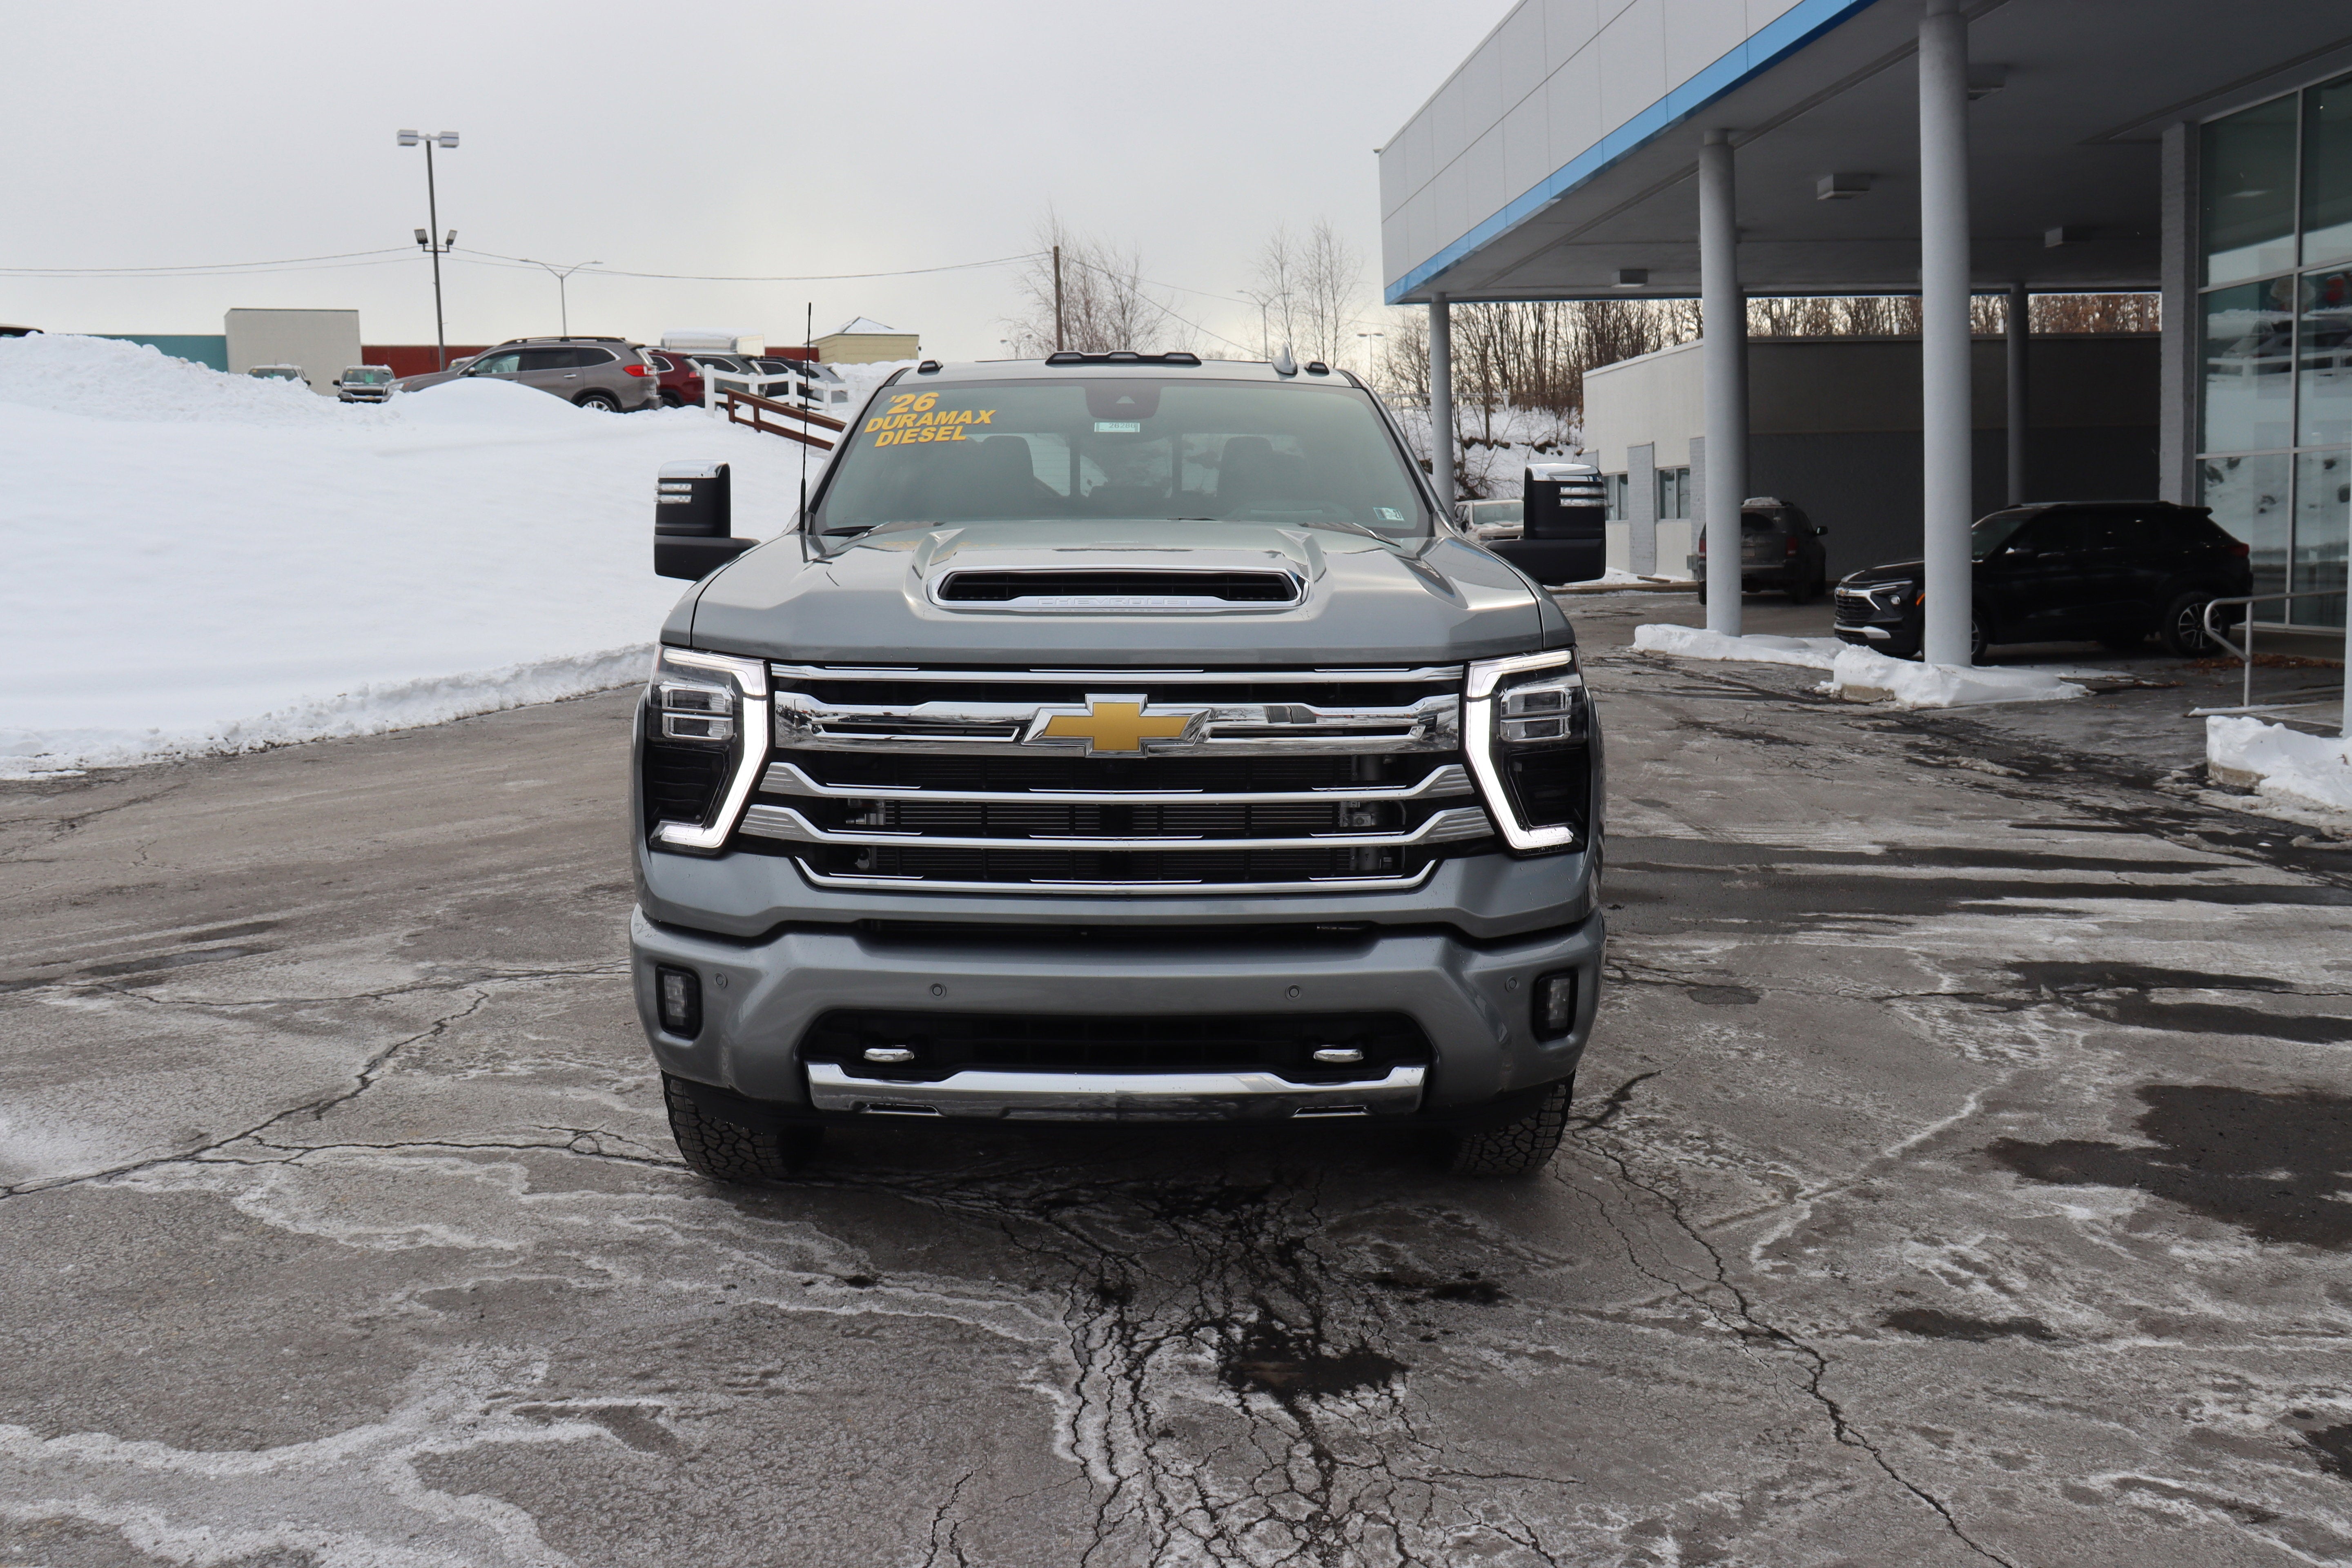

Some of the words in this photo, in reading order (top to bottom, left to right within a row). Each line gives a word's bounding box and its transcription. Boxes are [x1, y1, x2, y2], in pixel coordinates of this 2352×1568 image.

[886, 392, 939, 414] '26
[864, 410, 996, 433] DURAMAX
[874, 425, 967, 447] DIESEL
